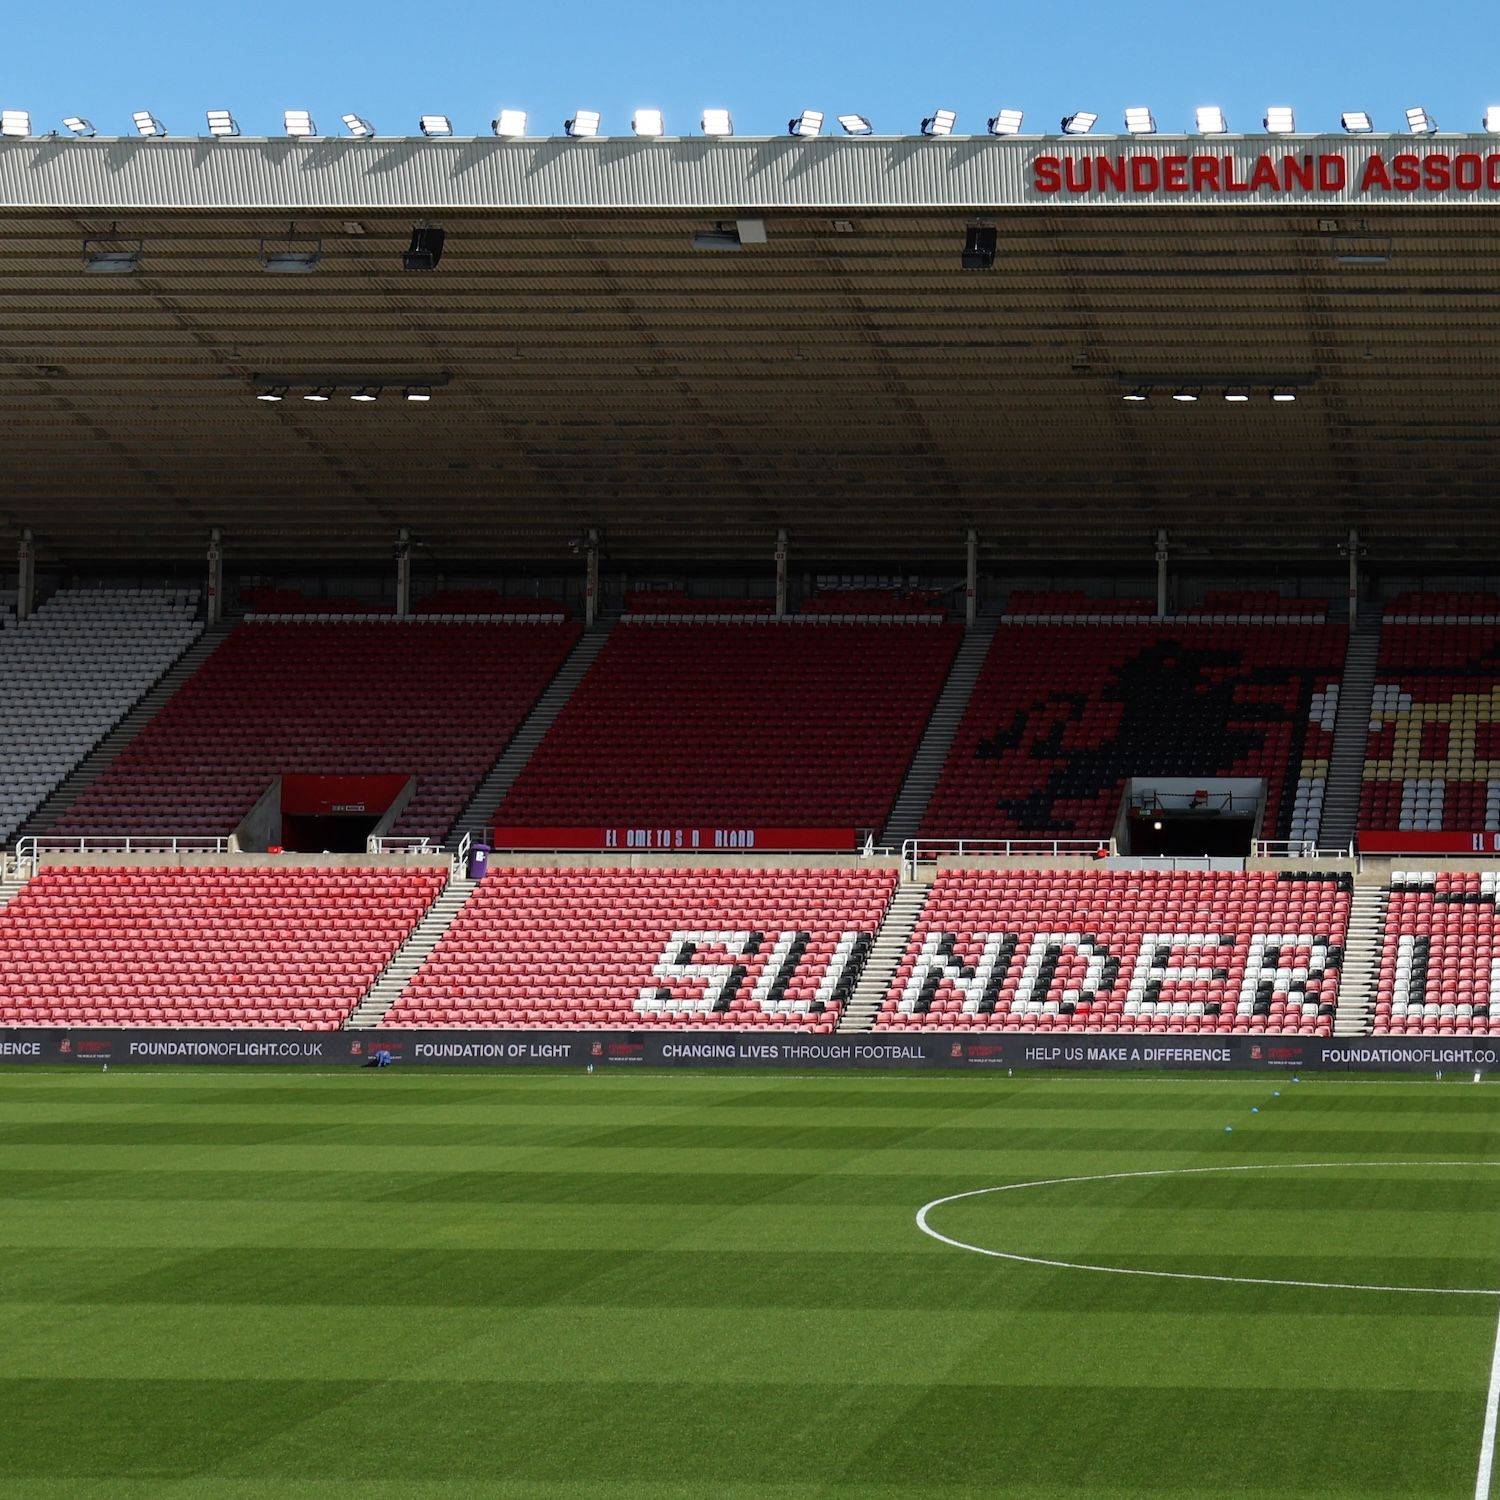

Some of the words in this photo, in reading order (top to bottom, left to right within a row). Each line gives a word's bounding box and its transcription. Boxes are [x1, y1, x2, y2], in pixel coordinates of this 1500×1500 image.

[1034, 153, 1346, 194] SUNDERLAND
[129, 1042, 323, 1057] FOUNDATIONOFLIGHT.CO.UK
[415, 1043, 504, 1057] FOUNDATION
[507, 1044, 528, 1058] OF
[530, 1044, 572, 1058] LIGHT
[662, 1044, 736, 1058] CHANGING
[739, 1045, 779, 1059] LIVES
[781, 1045, 851, 1059] THROUGH
[854, 1045, 926, 1059] FOOTBALL
[1025, 1047, 1062, 1061] HELP
[1064, 1047, 1084, 1061] US
[1087, 1047, 1128, 1061] MAKE
[1130, 1048, 1141, 1061] A
[1143, 1048, 1231, 1062] DIFFERENCE
